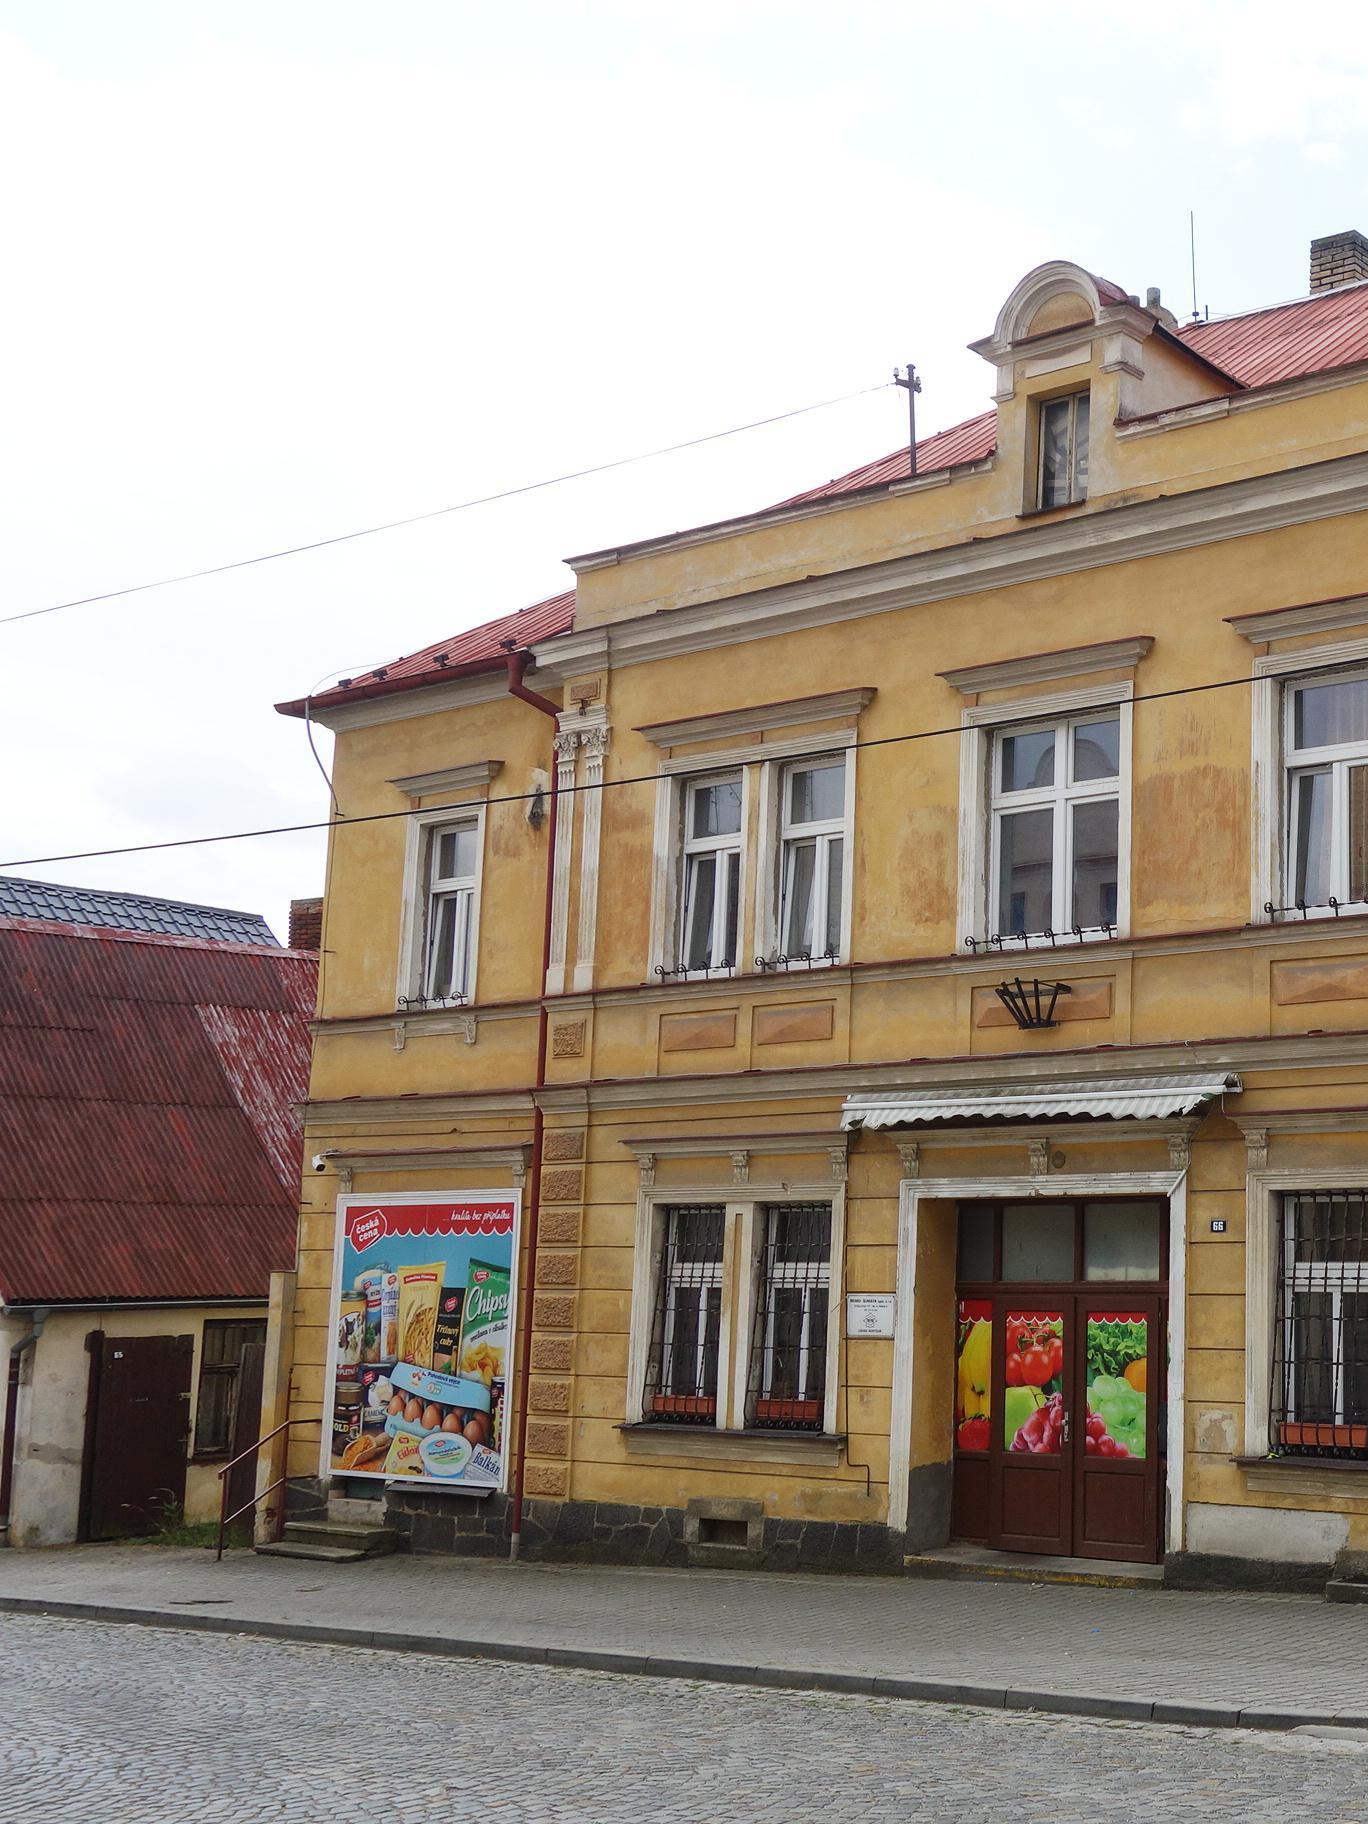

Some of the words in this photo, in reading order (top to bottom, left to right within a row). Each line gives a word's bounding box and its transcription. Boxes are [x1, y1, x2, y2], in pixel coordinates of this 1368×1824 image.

[356, 1217, 380, 1235] česká
[1213, 1221, 1224, 1231] 66
[358, 1228, 379, 1243] cena
[472, 1452, 500, 1476] Balkán
